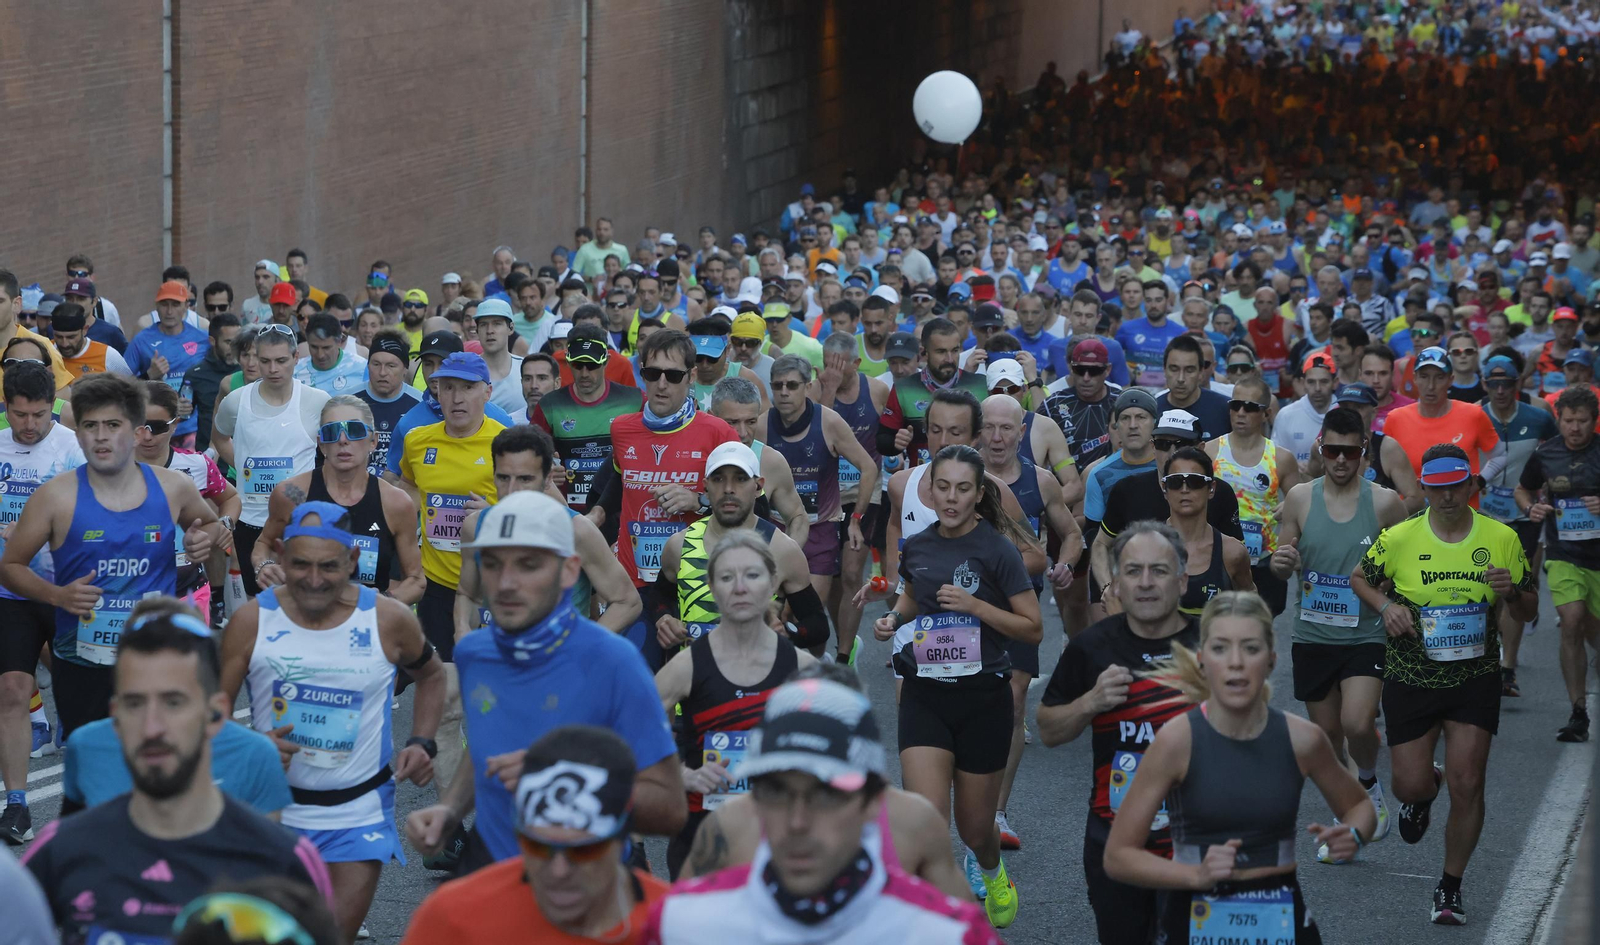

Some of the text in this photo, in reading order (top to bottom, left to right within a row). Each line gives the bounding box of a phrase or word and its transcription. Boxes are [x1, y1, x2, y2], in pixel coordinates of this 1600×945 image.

[11, 468, 39, 480] HUELVA
[623, 470, 700, 483] ISBILYA
[1562, 521, 1595, 529] ALVARO
[644, 543, 662, 551] 6181
[97, 558, 150, 577] PEDRO
[1321, 591, 1339, 600] 7079
[1311, 600, 1348, 613] JAVIER
[937, 616, 972, 626] ZURICH
[1447, 622, 1466, 631] 4662
[936, 635, 955, 645] 9584
[1425, 632, 1485, 648] CORTEGANA
[926, 647, 967, 661] GRACE
[302, 689, 353, 705] ZURICH
[300, 712, 327, 725] 5144
[325, 739, 354, 750] CARO
[1228, 913, 1258, 926] 7575
